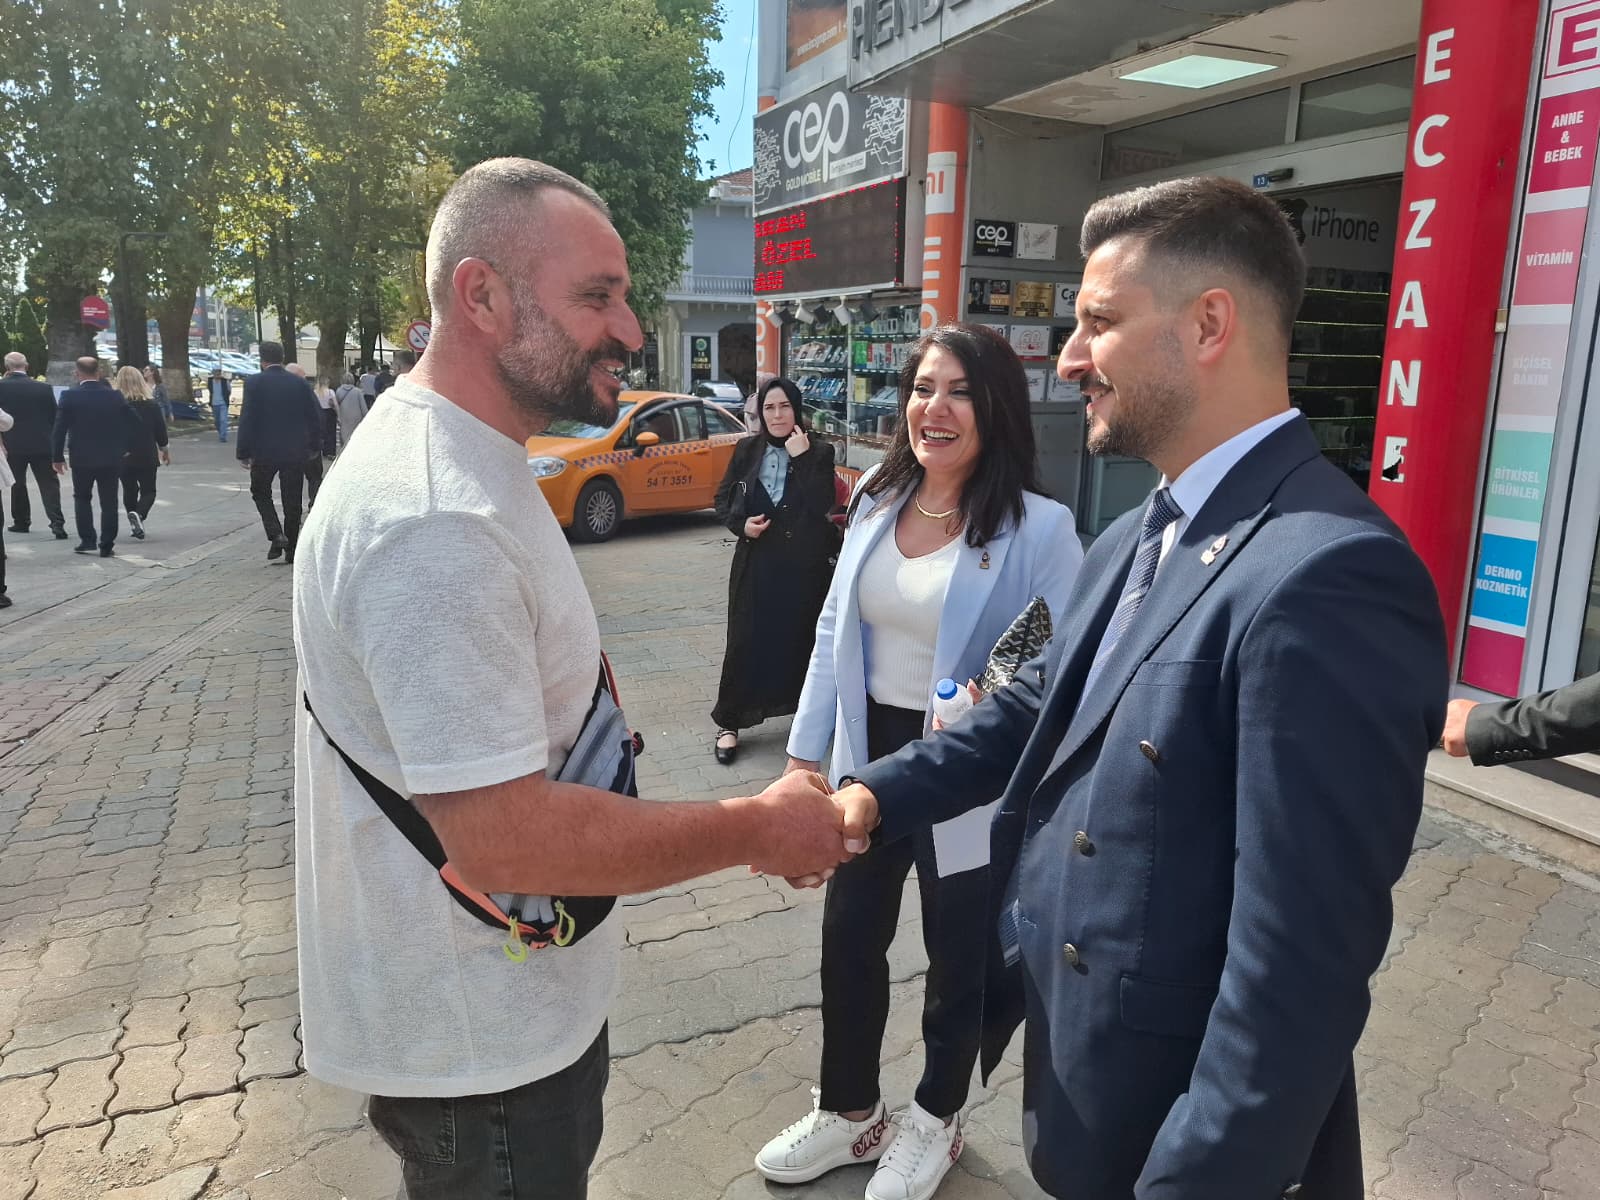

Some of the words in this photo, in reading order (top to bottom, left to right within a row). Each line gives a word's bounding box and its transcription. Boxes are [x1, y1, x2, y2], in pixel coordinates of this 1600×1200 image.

[1551, 110, 1585, 129] ANNE
[783, 91, 850, 184] cep
[1560, 130, 1570, 144] &
[1543, 146, 1583, 164] BEBEK
[1311, 205, 1380, 243] iPhone
[976, 225, 1008, 247] cep
[1381, 28, 1455, 483] ECZANE
[1526, 248, 1574, 267] VİTAMİN
[647, 477, 658, 488] 54
[662, 476, 668, 487] T
[670, 474, 692, 486] 3551
[1494, 467, 1540, 484] BİTKİSEL
[1491, 482, 1540, 500] ÜRÜNLER
[1484, 564, 1522, 581] DERMO
[1476, 578, 1528, 598] KOZMETİK
